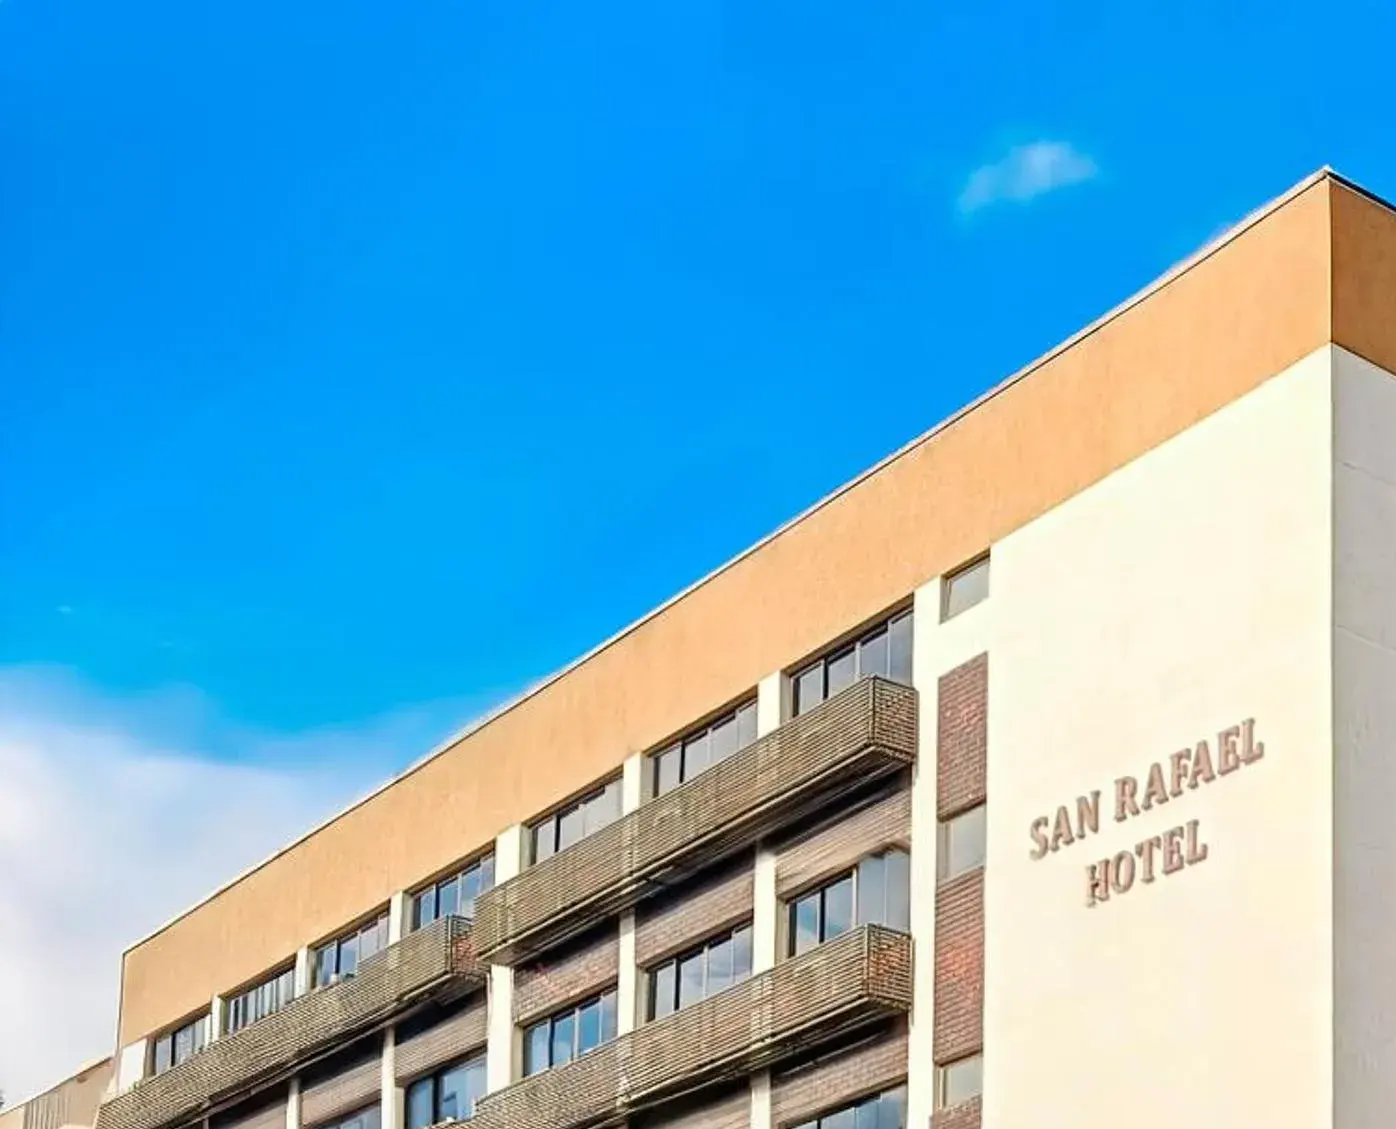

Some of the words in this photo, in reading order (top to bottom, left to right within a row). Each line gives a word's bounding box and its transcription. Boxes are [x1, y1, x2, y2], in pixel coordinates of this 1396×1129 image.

[1029, 789, 1101, 862] SAN
[1113, 716, 1265, 823] RAFAEL
[1085, 818, 1208, 908] HOTEL
